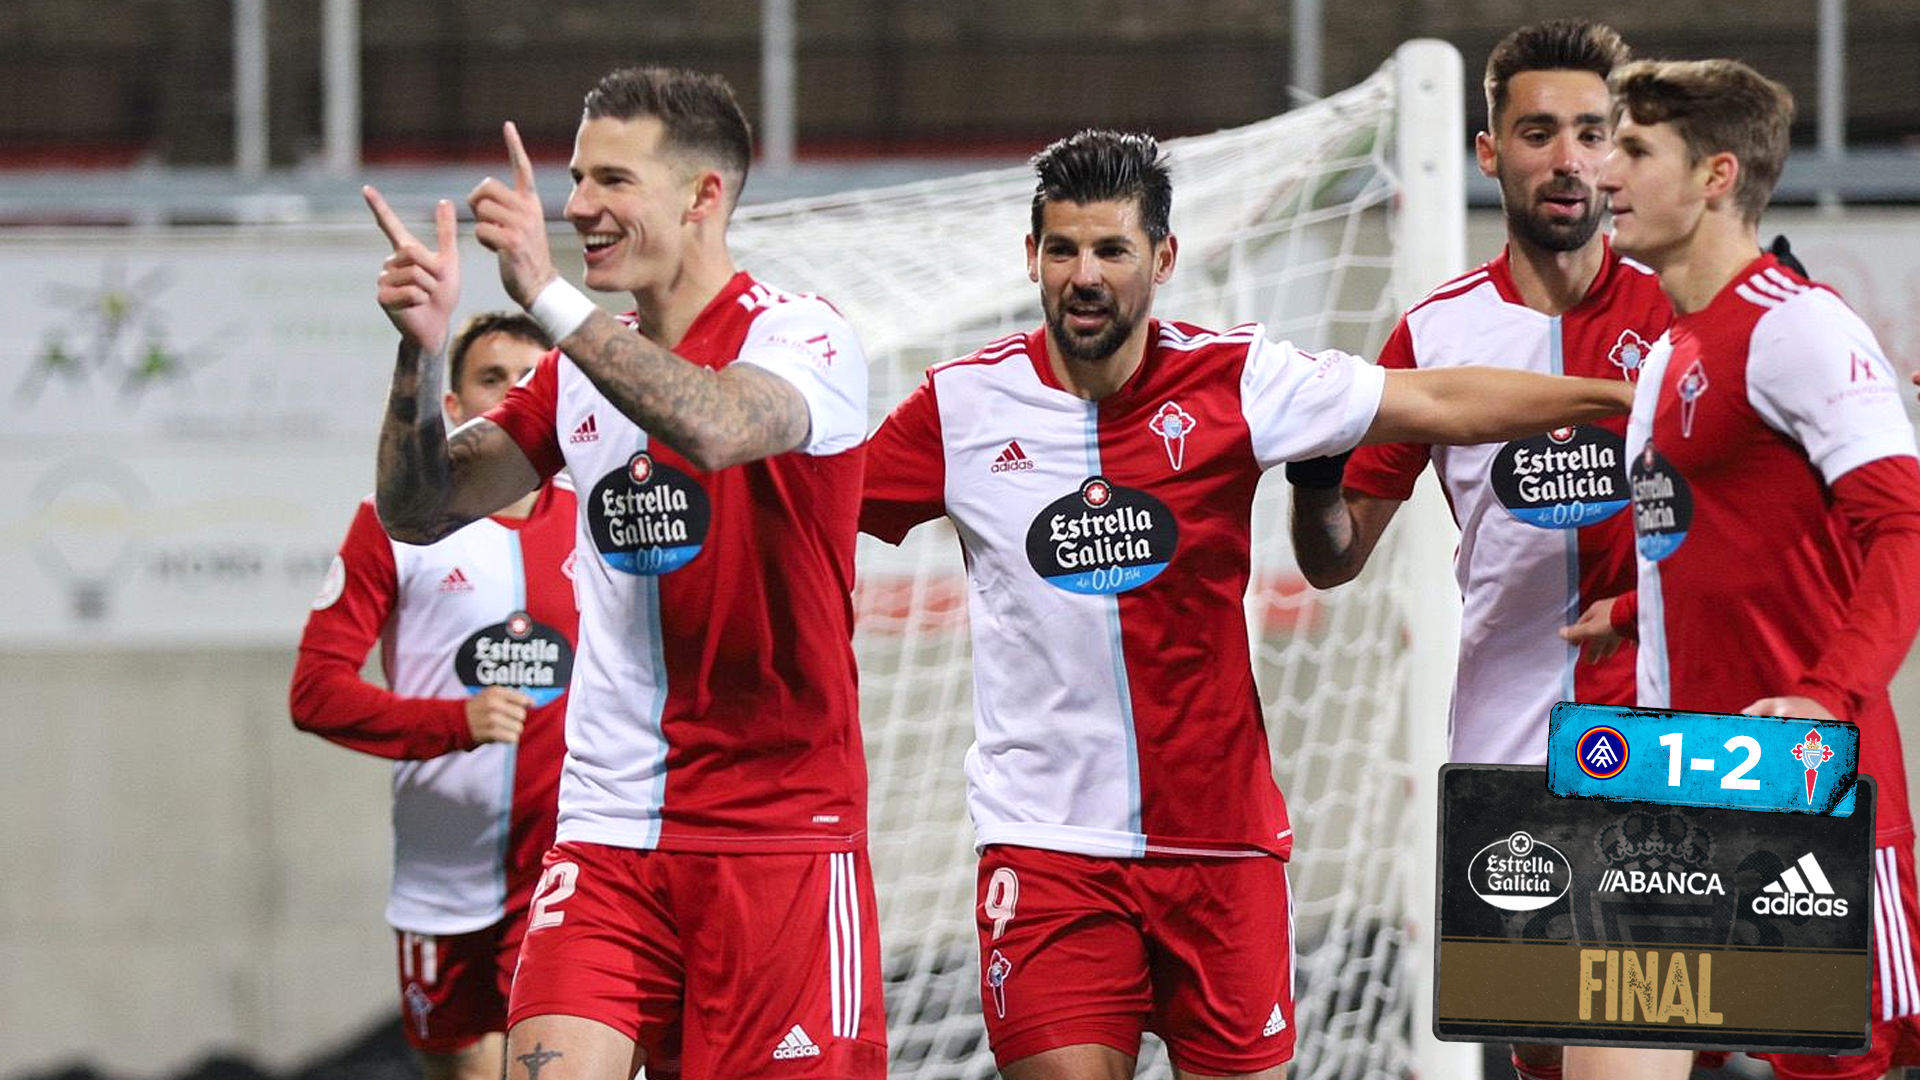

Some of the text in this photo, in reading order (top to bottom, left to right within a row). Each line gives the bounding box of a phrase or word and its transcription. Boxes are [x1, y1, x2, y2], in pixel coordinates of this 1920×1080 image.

[991, 460, 1034, 473] adidas
[1513, 443, 1616, 475] Estrella
[602, 484, 689, 517] Estrella
[1519, 470, 1614, 503] Galicia
[609, 513, 688, 546] Galicia
[1049, 506, 1153, 542] Estrella
[1056, 534, 1152, 569] Galicia
[1093, 564, 1123, 590] 0,0
[474, 637, 560, 662] Estrella
[475, 659, 555, 686] Galicia
[985, 867, 1019, 940] 9
[773, 1044, 821, 1060] adidas
